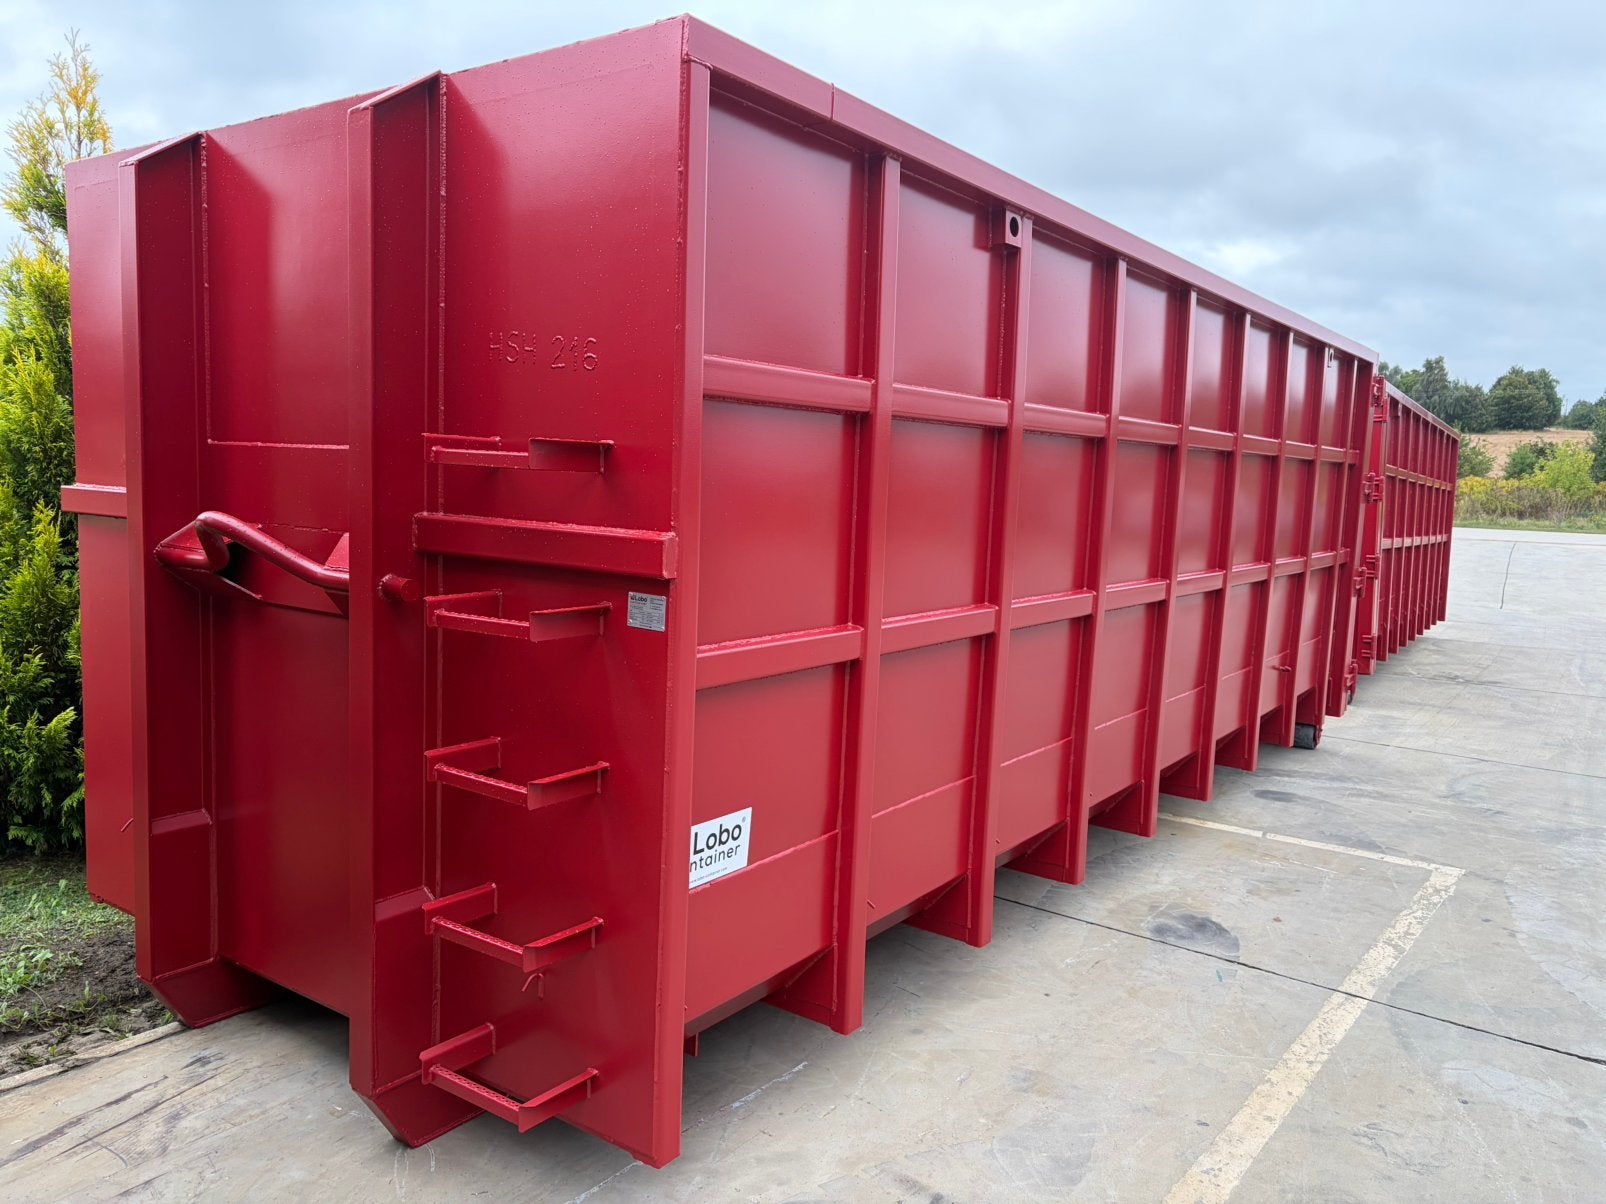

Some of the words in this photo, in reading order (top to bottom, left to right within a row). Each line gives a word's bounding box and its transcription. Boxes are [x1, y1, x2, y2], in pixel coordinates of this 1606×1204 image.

[488, 331, 536, 365] HSH
[548, 335, 598, 371] 216
[693, 824, 742, 855] Lobo
[690, 844, 741, 872] ntainer
